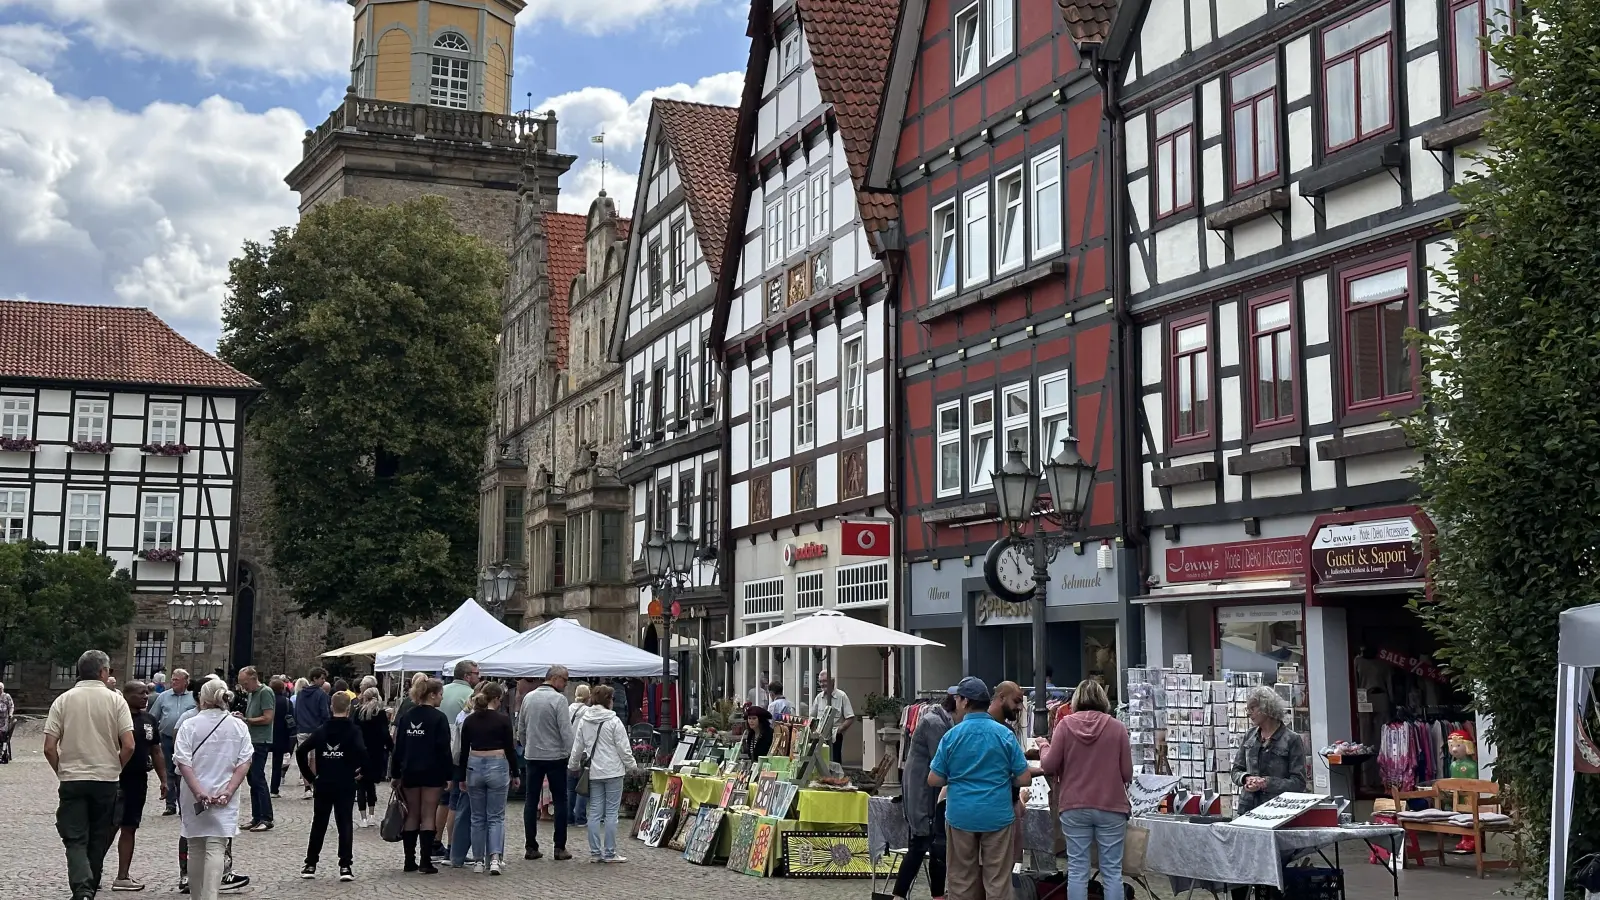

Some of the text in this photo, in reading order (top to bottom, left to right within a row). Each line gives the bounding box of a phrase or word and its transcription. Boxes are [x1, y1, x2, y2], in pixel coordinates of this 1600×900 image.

[1322, 527, 1356, 544] Jenny's
[1360, 526, 1409, 540] Mode Deko Accessoires
[1169, 548, 1219, 576] Jenny's
[1225, 546, 1303, 570] Mode Deko Accessoires
[1326, 544, 1407, 569] Gusti & Sapori
[1062, 571, 1102, 590] Schmuck
[928, 586, 950, 601] Uhren
[1380, 649, 1406, 667] SALE
